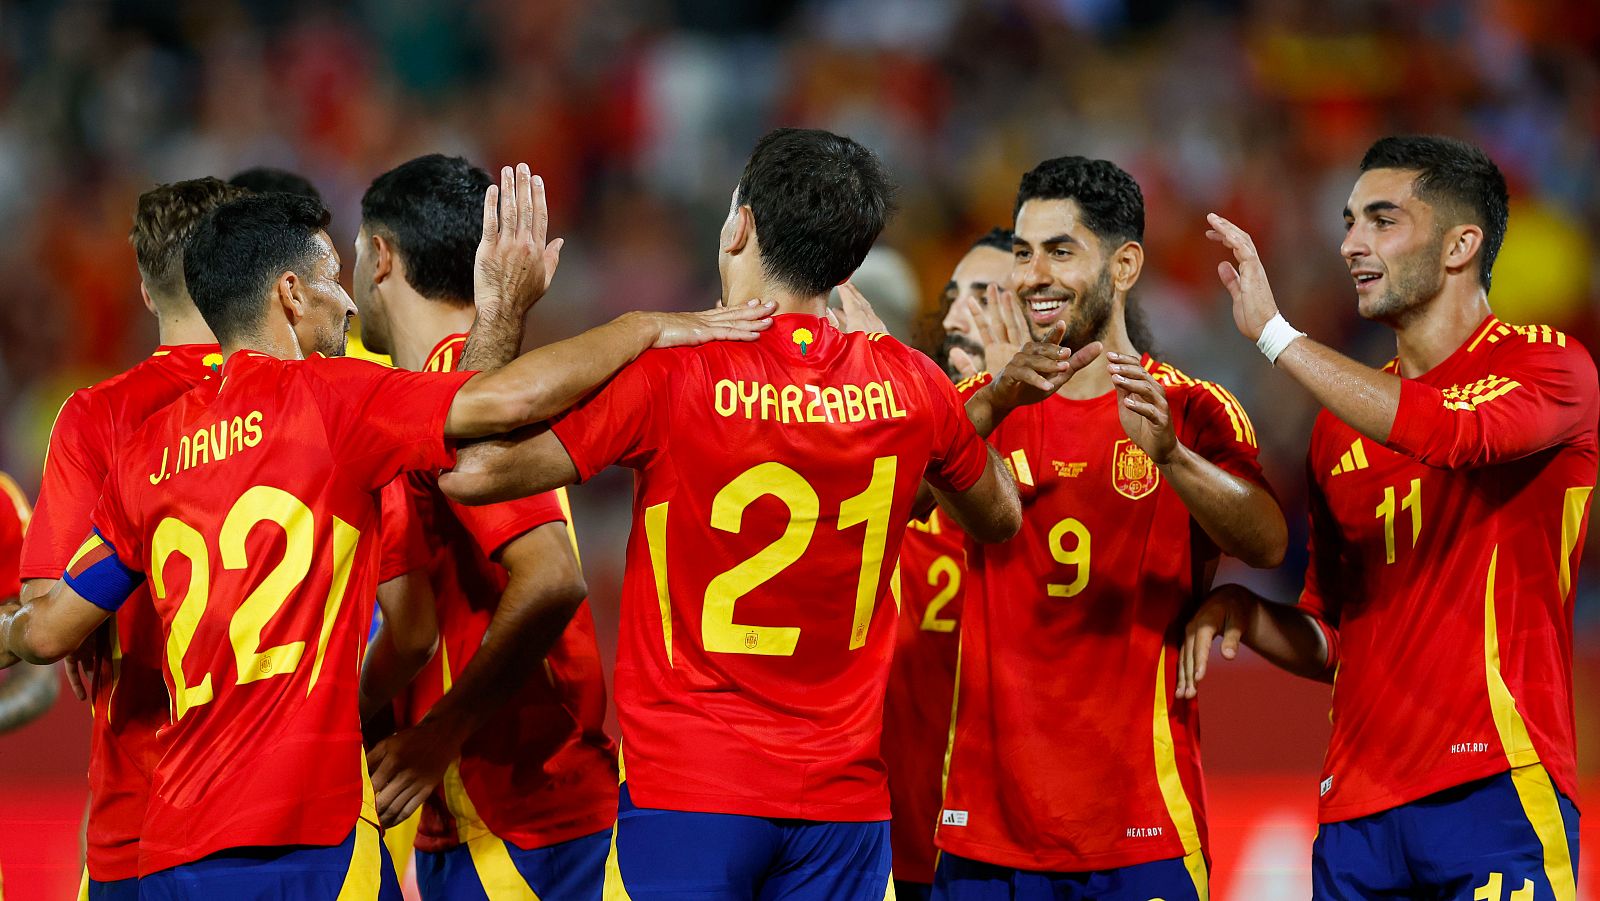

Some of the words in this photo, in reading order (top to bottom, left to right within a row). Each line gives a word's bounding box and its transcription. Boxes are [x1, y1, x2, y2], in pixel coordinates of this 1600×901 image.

[714, 379, 907, 424] OYARZABAL
[149, 446, 171, 485] J.
[175, 410, 263, 474] NAVAS
[702, 455, 898, 656] 21
[1047, 517, 1091, 598] 9
[1375, 478, 1422, 564] 11
[150, 484, 314, 721] 22
[1451, 742, 1489, 754] HEAT.RDY
[1126, 826, 1163, 838] HEAT.RDY
